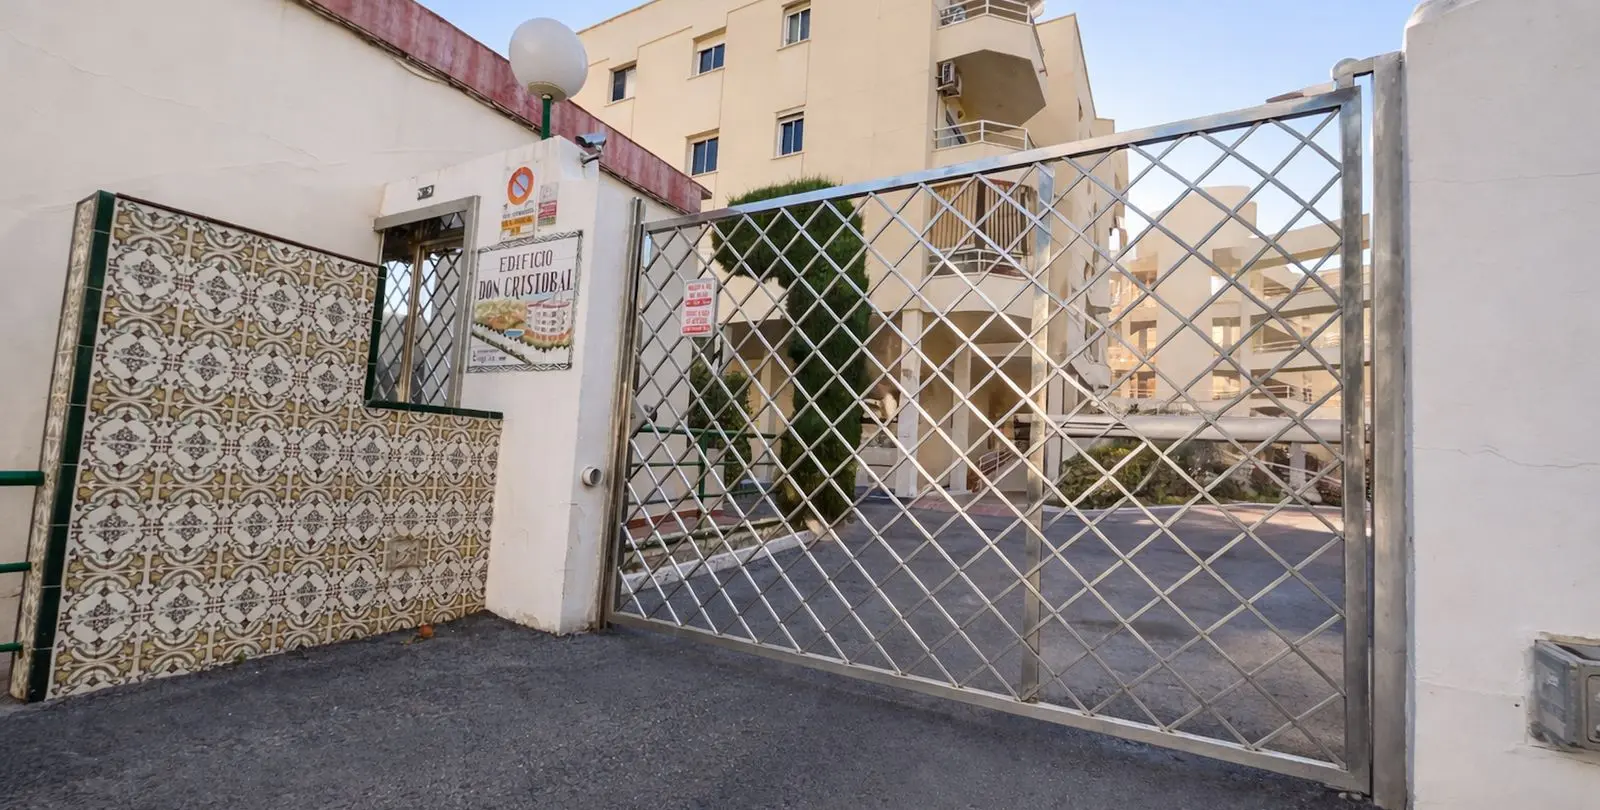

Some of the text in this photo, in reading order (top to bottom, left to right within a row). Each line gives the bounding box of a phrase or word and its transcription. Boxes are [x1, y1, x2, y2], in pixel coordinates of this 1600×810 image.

[500, 249, 553, 272] EDIFICIO
[479, 269, 574, 300] DON CRISTOBAL
